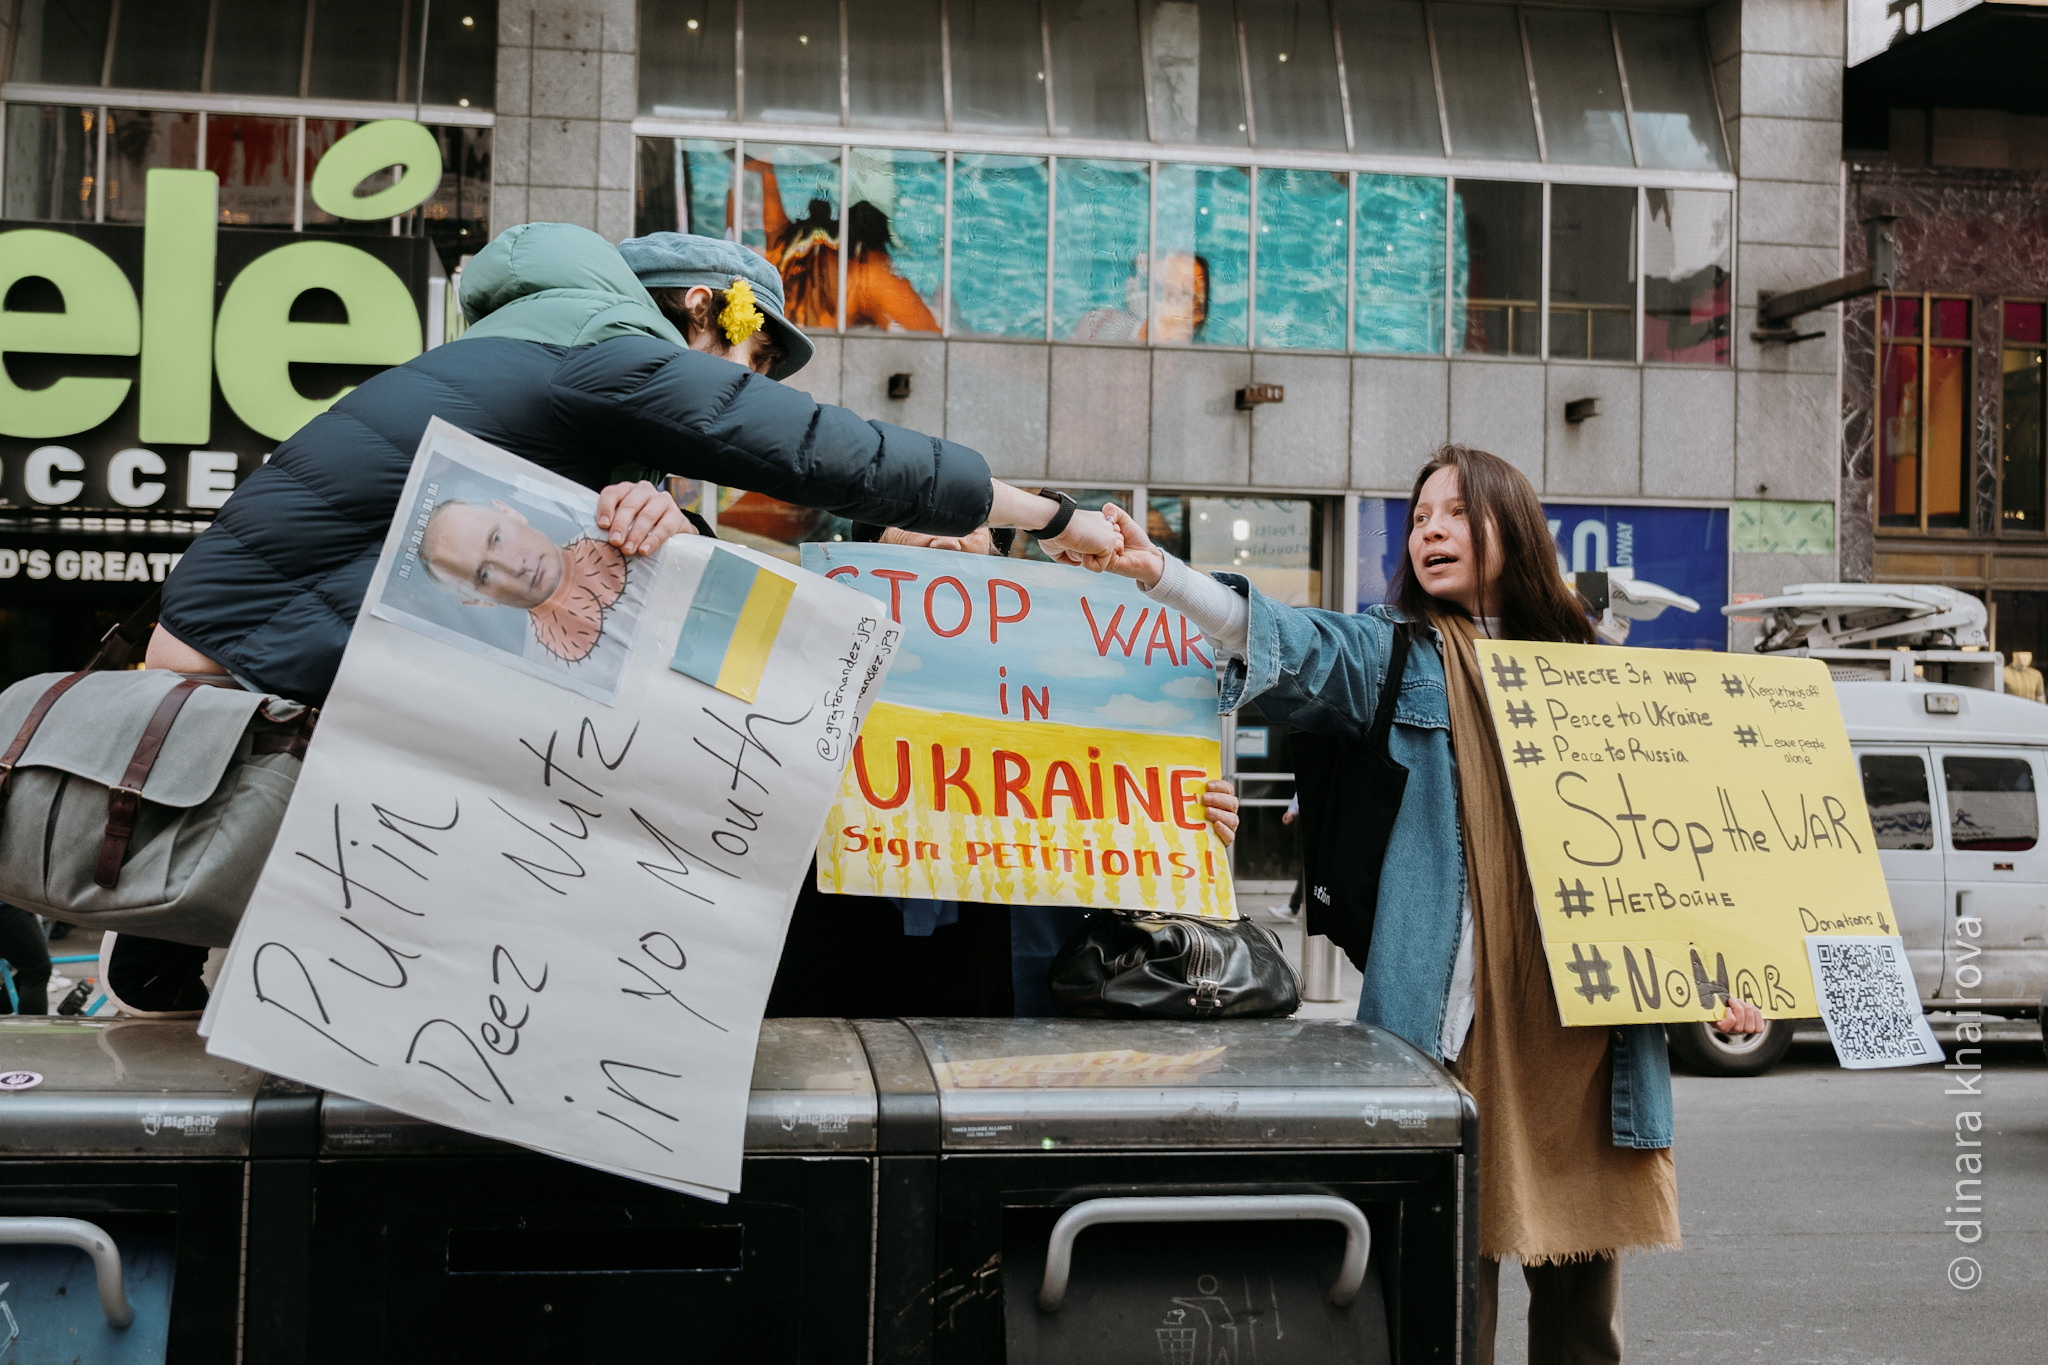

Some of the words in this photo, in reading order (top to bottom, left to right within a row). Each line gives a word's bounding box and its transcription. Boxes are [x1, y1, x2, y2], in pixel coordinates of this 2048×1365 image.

[1769, 698, 1805, 714] people
[1628, 737, 1689, 763] Russia
[1784, 753, 1812, 765] alone
[842, 824, 941, 868] Sign
[1555, 770, 1714, 881] Stop
[1716, 786, 1771, 853] the
[1761, 789, 1862, 854] WAR
[252, 797, 460, 1067] Putin
[406, 943, 549, 1106] Deez
[489, 715, 642, 897] Nutz
[563, 1058, 683, 1153] in
[629, 697, 817, 906] Mouth
[1798, 906, 1874, 934] Donations
